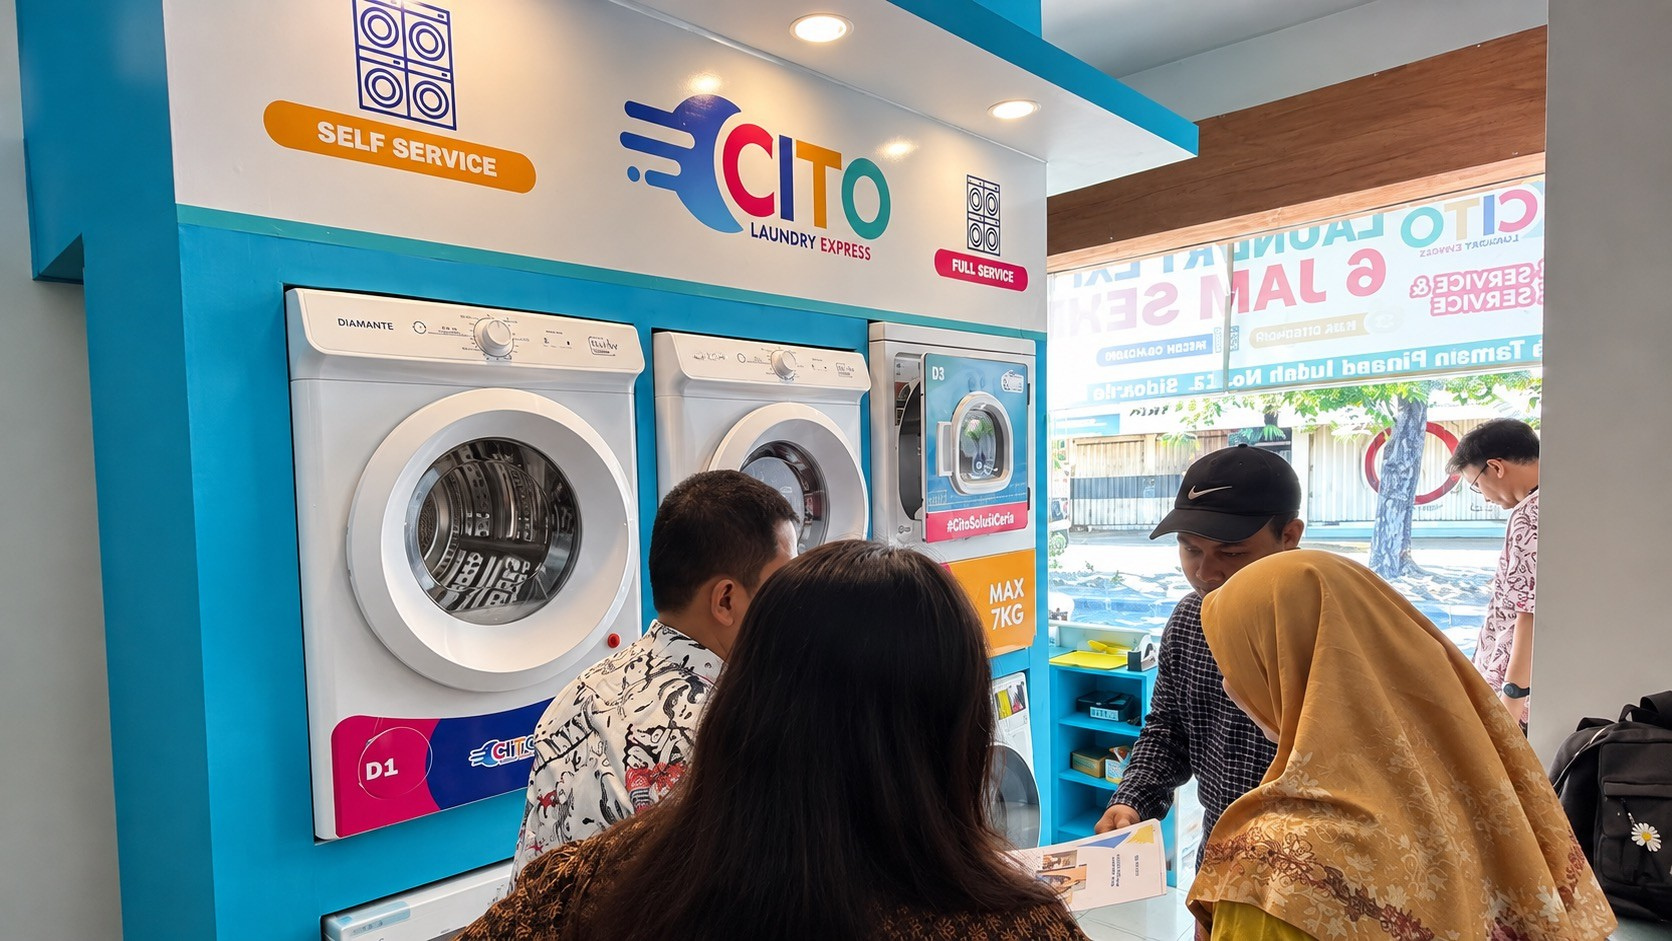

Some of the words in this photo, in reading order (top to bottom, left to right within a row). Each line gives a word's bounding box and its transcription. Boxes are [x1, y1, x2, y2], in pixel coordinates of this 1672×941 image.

[317, 119, 386, 156] SELF
[393, 137, 499, 179] SERVICE
[721, 122, 892, 241] CITO
[750, 221, 816, 250] LAUNDRY
[819, 236, 873, 262] EXPRESS
[952, 258, 976, 276] FULL
[978, 264, 1015, 284] SERVICE
[337, 317, 394, 332] DIAMANTE
[931, 366, 946, 382] D3
[946, 511, 1015, 533] #CitoSolusiCeria
[989, 577, 1025, 606] MAX
[990, 602, 1024, 631] 7KG
[365, 757, 399, 781] D1
